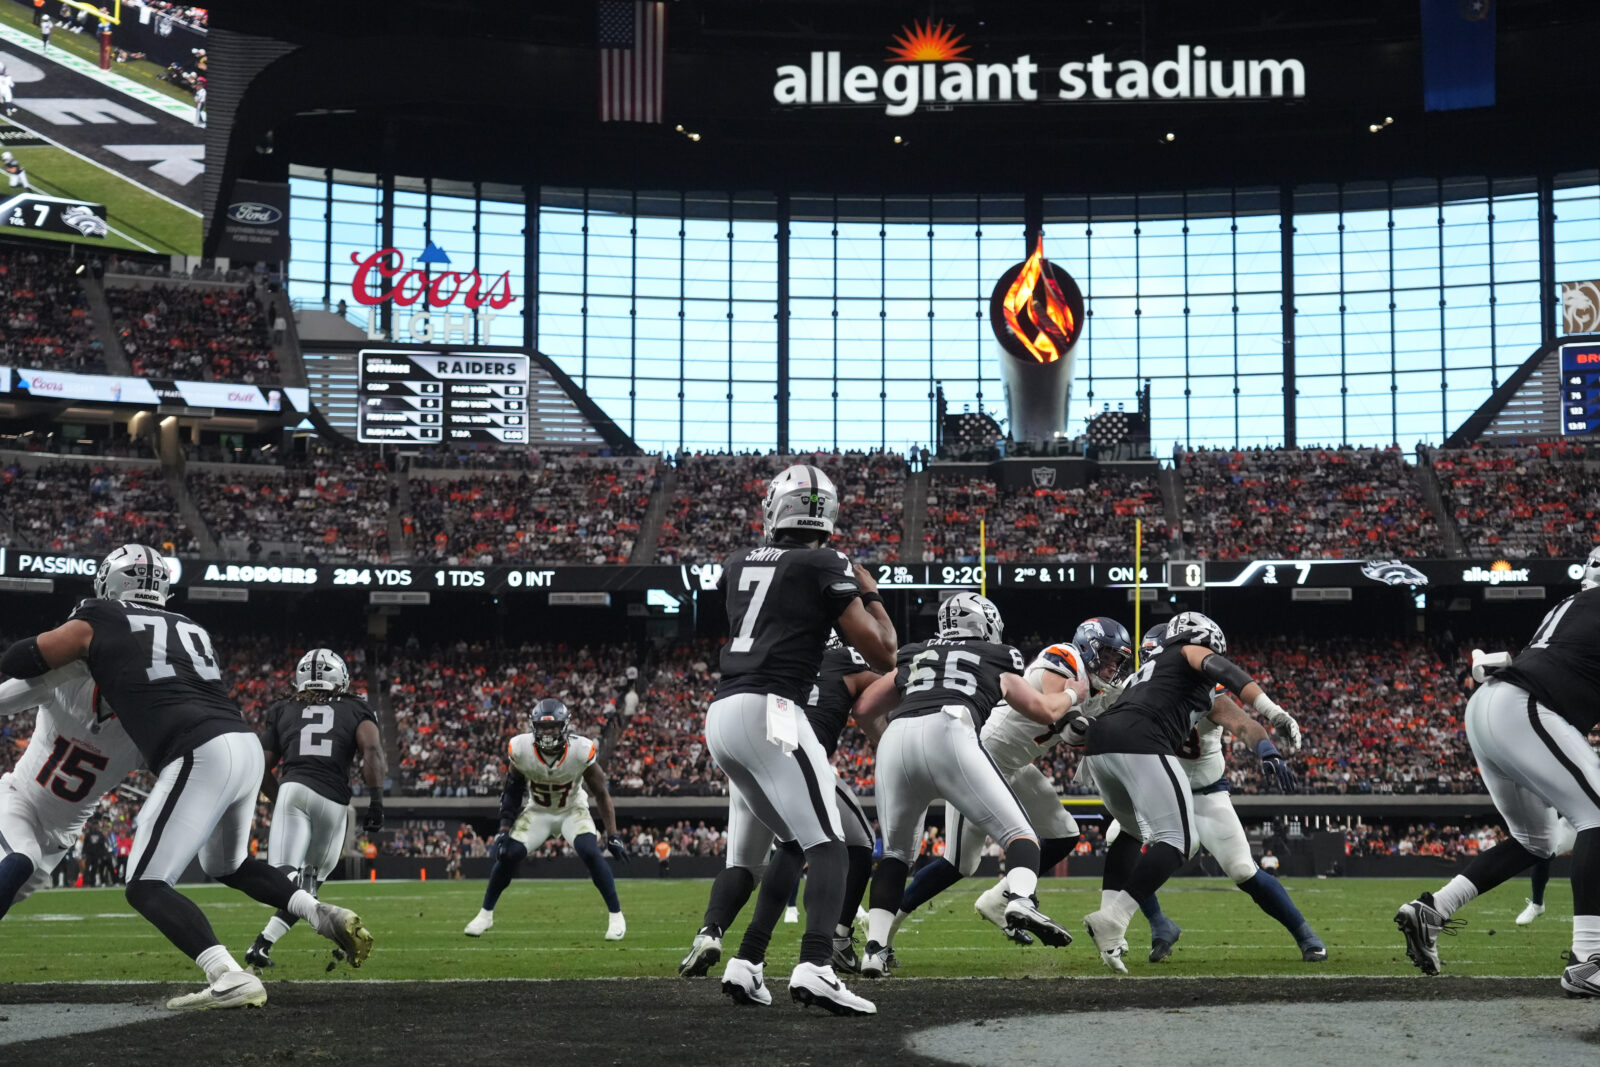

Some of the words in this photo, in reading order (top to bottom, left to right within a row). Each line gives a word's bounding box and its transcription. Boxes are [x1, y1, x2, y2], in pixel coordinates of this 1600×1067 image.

[773, 51, 1038, 116] allegiant
[1058, 44, 1306, 100] stadium
[33, 204, 50, 227] 7
[235, 205, 273, 221] Ford
[350, 247, 517, 310] Coors
[367, 310, 497, 345] LIGHT
[437, 361, 517, 376] RAIDERS
[31, 376, 64, 392] Coors
[227, 391, 254, 403] Chill
[797, 520, 825, 528] RAIDERS
[745, 547, 790, 562] SMITH
[18, 554, 97, 577] PASSING
[203, 564, 318, 585] A.RODGERS
[878, 565, 892, 584] 2
[941, 566, 987, 584] 9:20
[1039, 567, 1052, 582] &
[1057, 567, 1075, 582] 11
[1108, 567, 1134, 581] ON
[1138, 567, 1149, 581] 4
[1265, 565, 1276, 578] 3
[1294, 563, 1312, 585] 7
[332, 568, 372, 585] 284
[374, 569, 413, 586] YDS
[434, 570, 445, 587] 1
[448, 570, 486, 587] TDS
[507, 570, 523, 588] 0
[525, 570, 556, 587] INT
[1185, 564, 1201, 587] 0
[1462, 566, 1530, 585] allegiant
[134, 593, 160, 602] RAIDERS
[730, 566, 777, 653] 7
[126, 614, 222, 681] 70
[905, 649, 981, 696] 65
[299, 705, 335, 757] 2
[35, 735, 110, 803] 15
[530, 780, 573, 809] 57
[408, 820, 446, 830] FIELD
